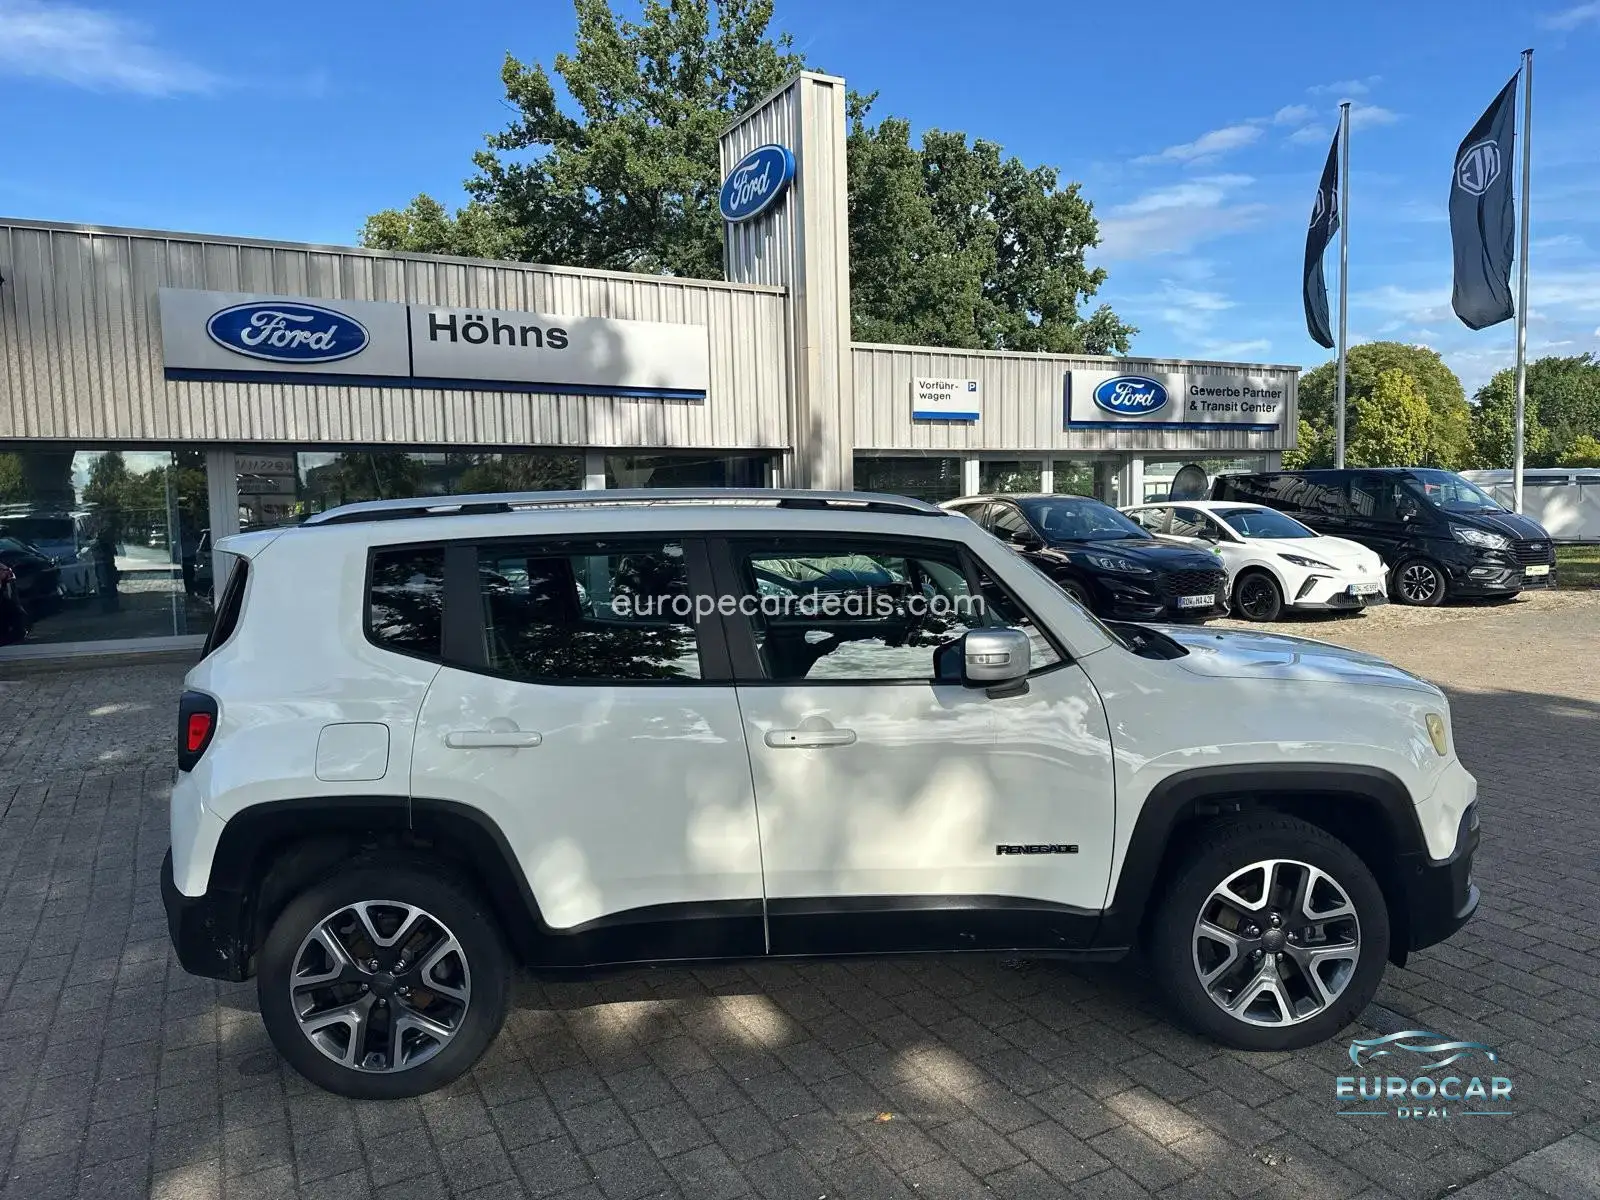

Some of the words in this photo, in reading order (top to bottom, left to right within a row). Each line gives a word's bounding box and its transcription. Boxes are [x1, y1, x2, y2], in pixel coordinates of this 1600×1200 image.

[730, 159, 771, 211] Ford
[240, 310, 338, 351] Ford
[428, 312, 570, 350] Höhns
[919, 381, 959, 390] Vorführ-
[1190, 385, 1240, 397] Gewerbe
[1243, 387, 1282, 399] Partner
[919, 393, 951, 402] wagen
[1110, 382, 1155, 407] Ford
[1190, 401, 1197, 411] &
[1202, 402, 1238, 412] Transit
[1240, 402, 1276, 413] Center
[996, 845, 1078, 855] RENEGADE
